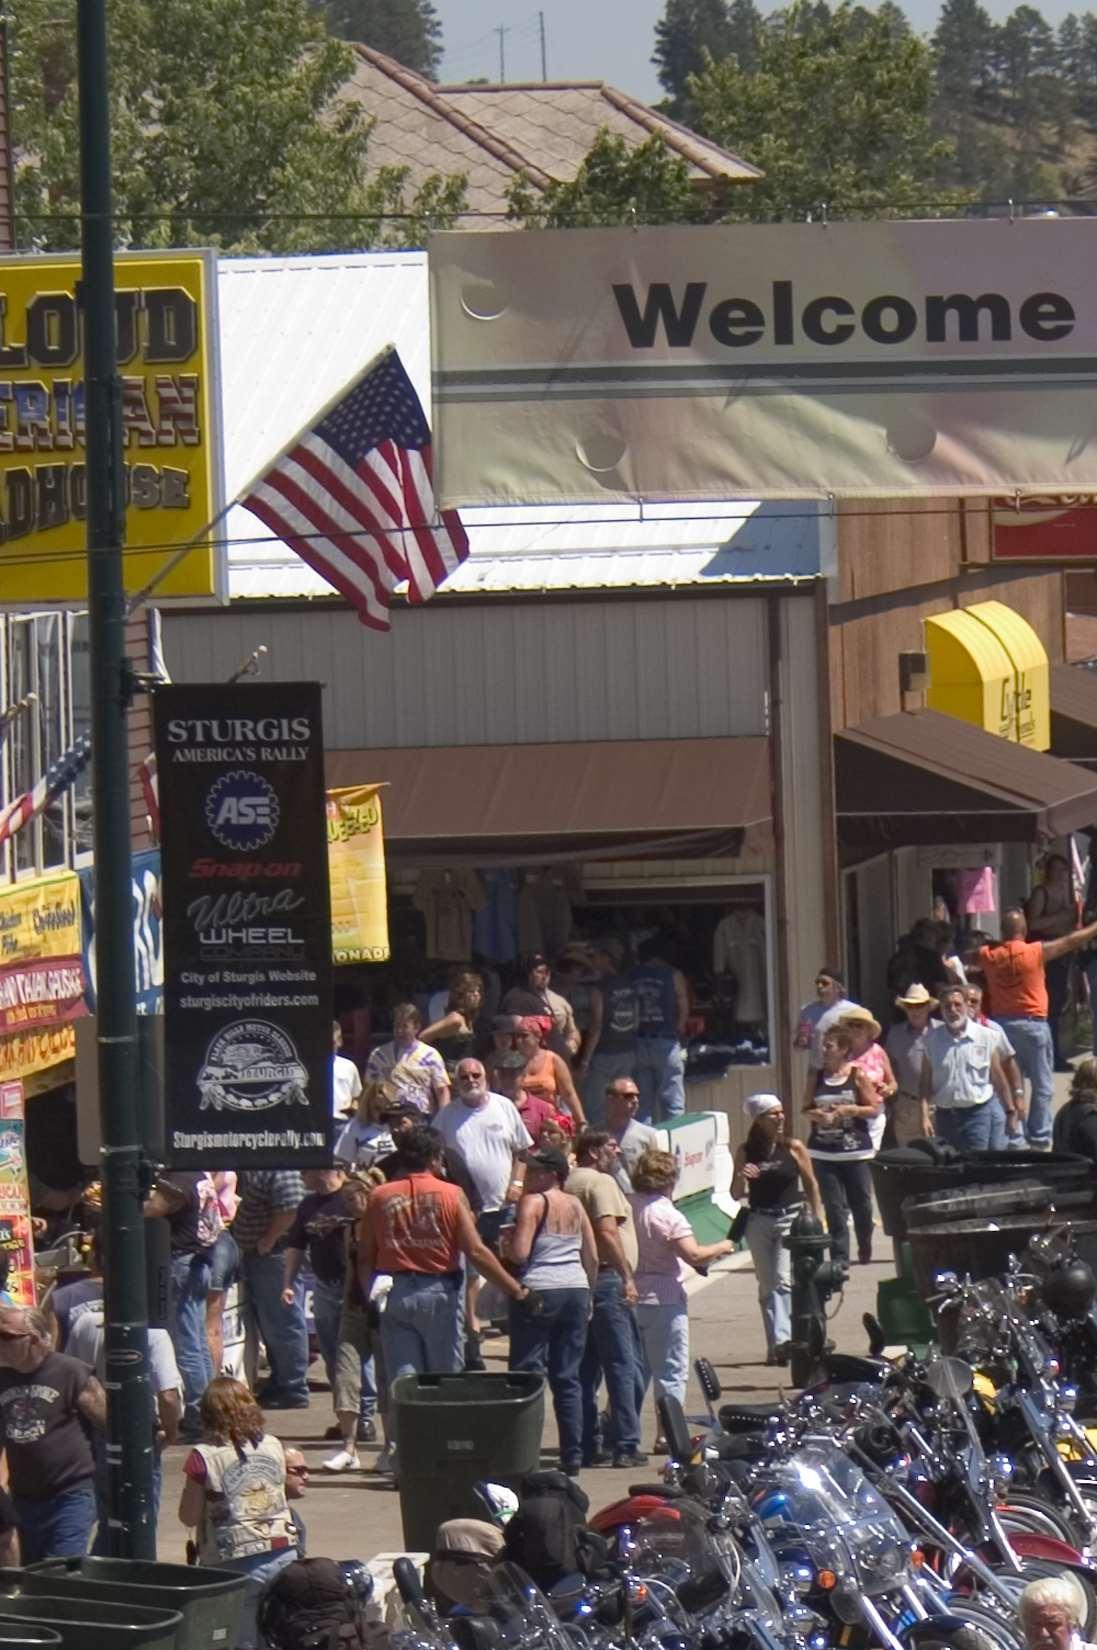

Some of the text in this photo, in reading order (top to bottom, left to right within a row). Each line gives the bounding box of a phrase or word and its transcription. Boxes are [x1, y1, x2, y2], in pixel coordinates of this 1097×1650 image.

[612, 279, 1077, 348] Welcome
[167, 717, 311, 743] STURGIS
[172, 746, 310, 763] AMERICA'S RALLY
[216, 796, 272, 826] ASE
[186, 888, 305, 932] Ultra
[199, 928, 305, 944] WHEEL
[180, 969, 317, 986] City of Sturgis Website
[180, 994, 320, 1011] sturgiscityofriders.com
